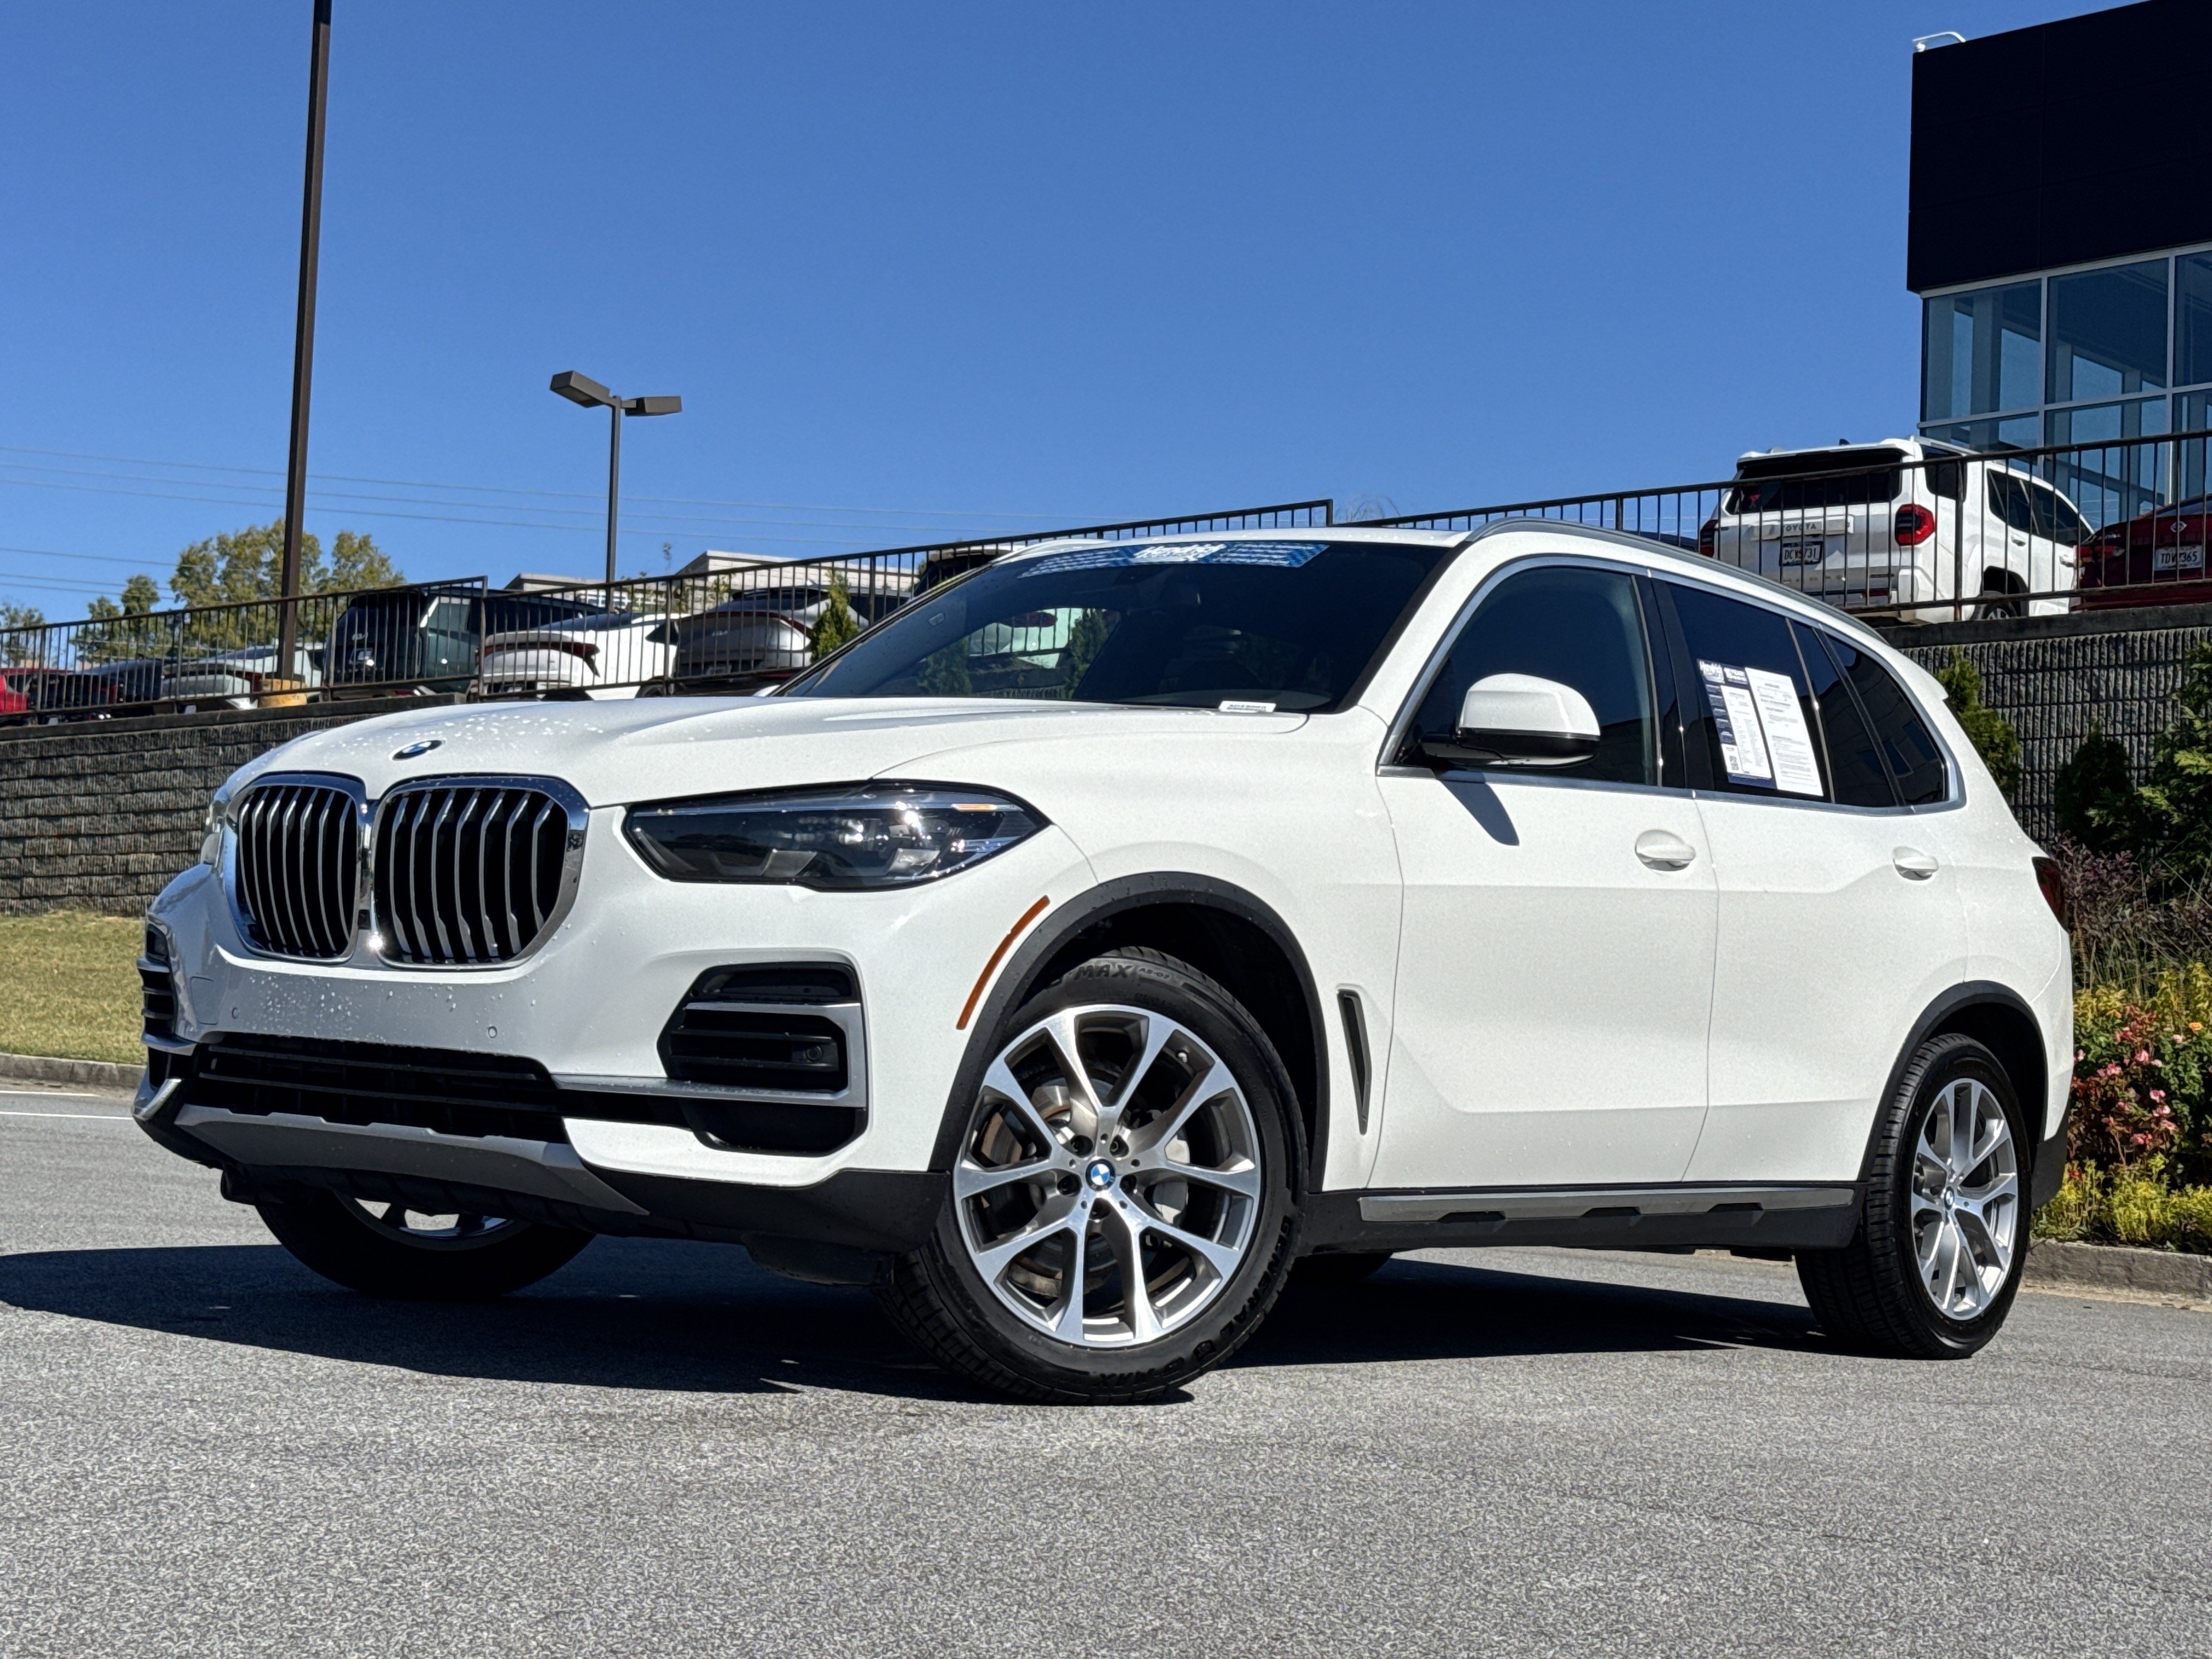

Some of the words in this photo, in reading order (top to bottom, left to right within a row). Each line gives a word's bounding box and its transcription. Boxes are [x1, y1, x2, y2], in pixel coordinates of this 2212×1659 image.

[1781, 523, 1817, 532] OYTA
[2160, 551, 2198, 564] TDV365
[1219, 1215, 1293, 1336] GENERAL
